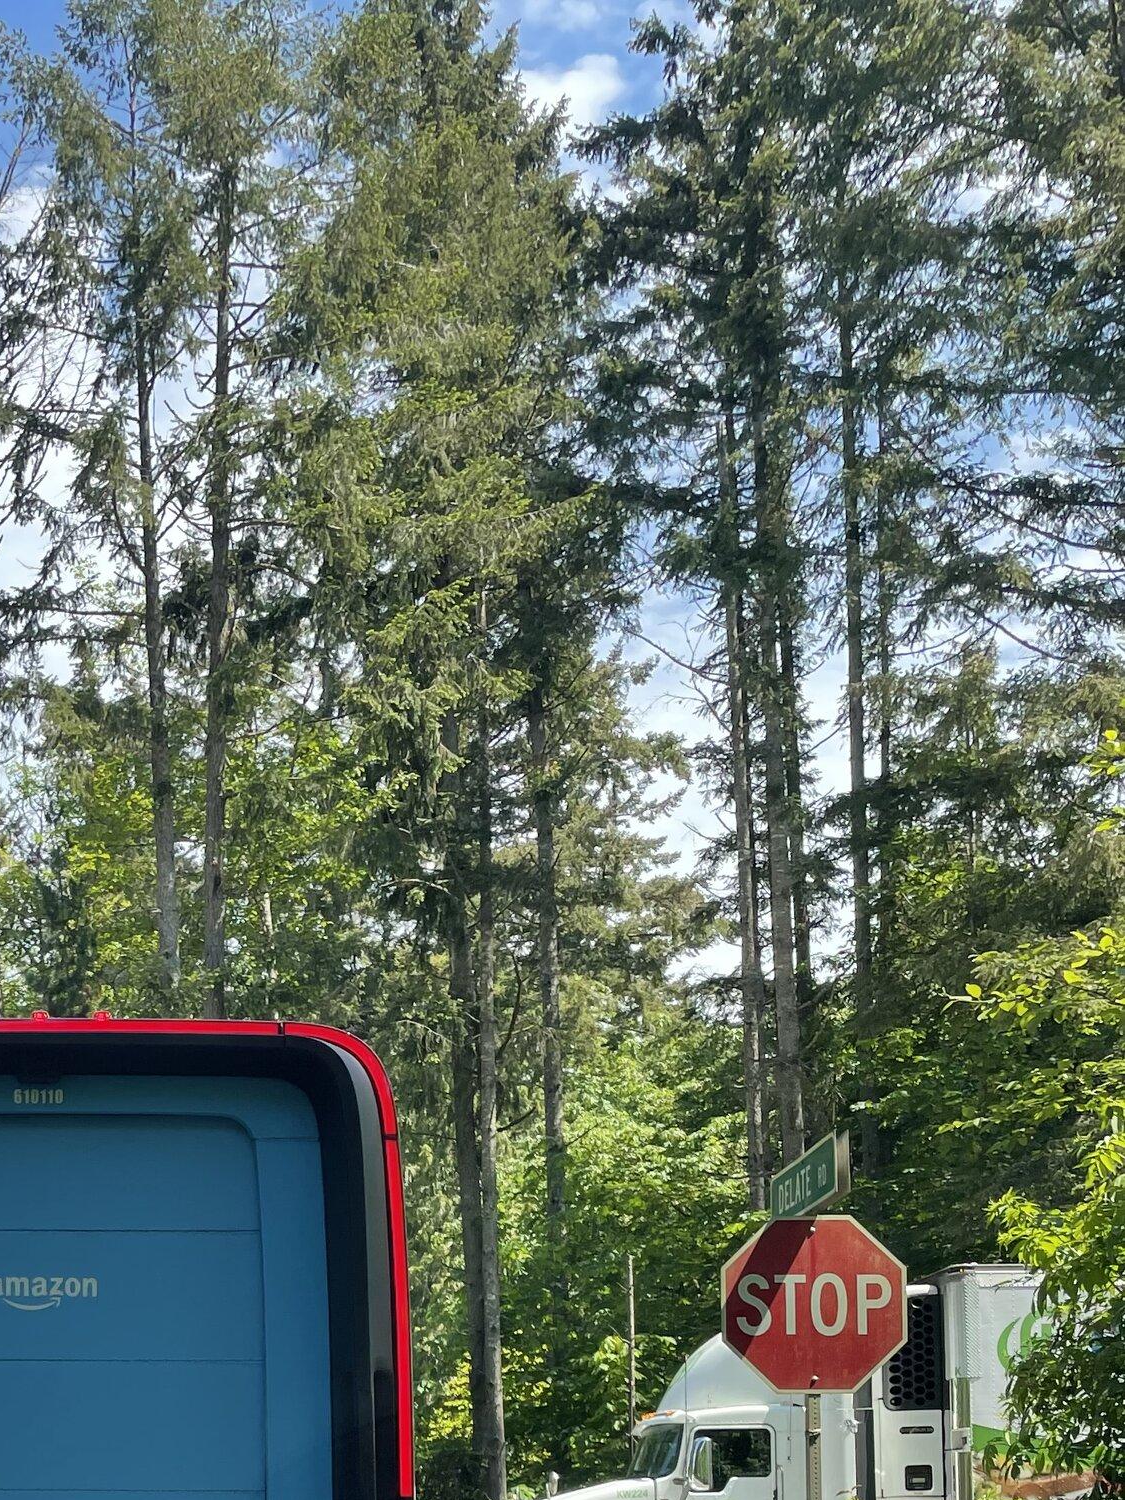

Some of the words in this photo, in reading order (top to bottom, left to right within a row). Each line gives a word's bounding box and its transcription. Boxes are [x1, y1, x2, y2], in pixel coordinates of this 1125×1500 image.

[13, 1088, 64, 1105] 610110
[778, 1164, 812, 1215] DELATE
[817, 1163, 827, 1189] RD
[736, 1273, 893, 1337] STOP
